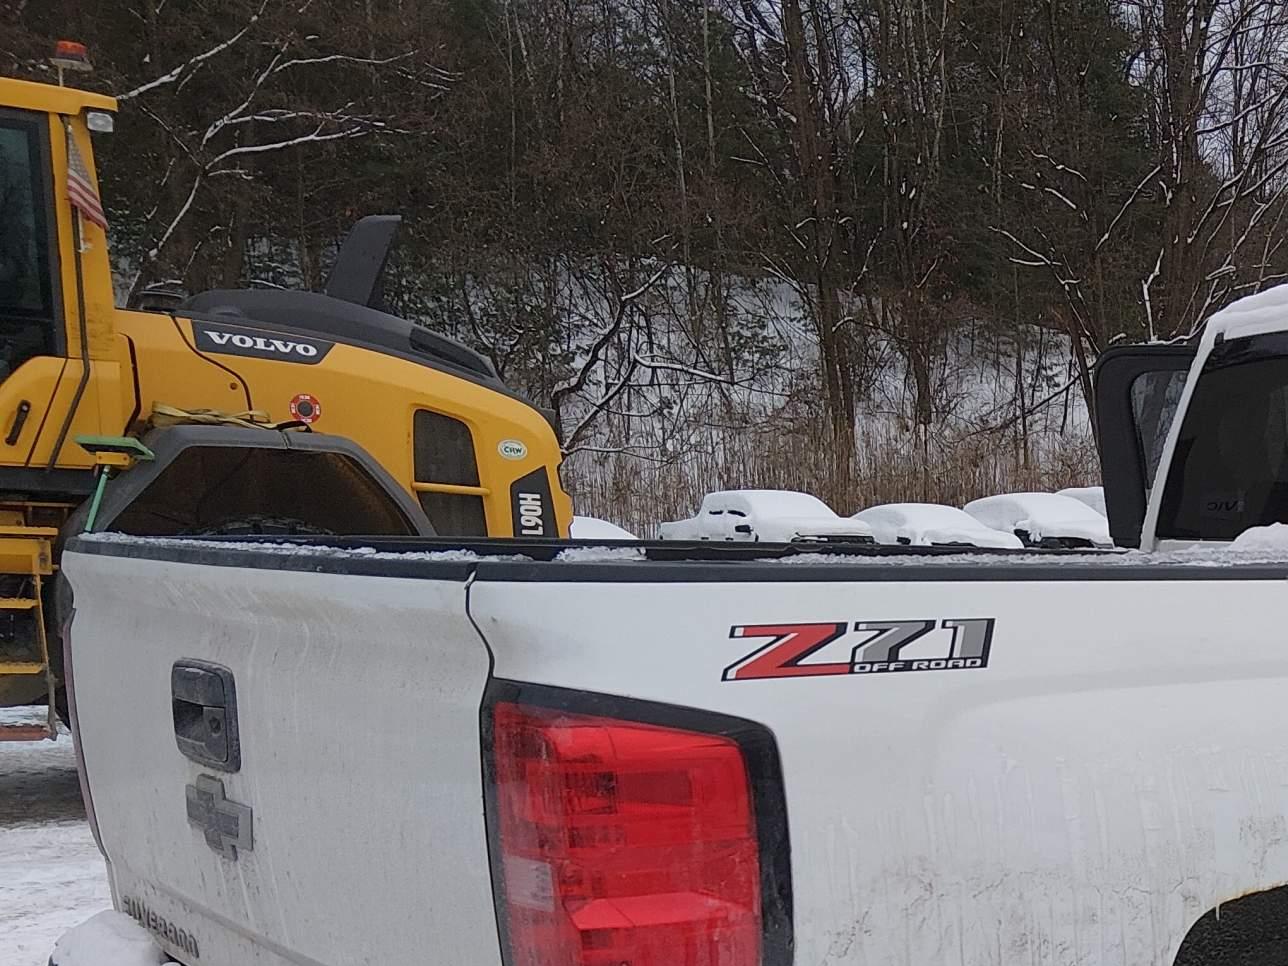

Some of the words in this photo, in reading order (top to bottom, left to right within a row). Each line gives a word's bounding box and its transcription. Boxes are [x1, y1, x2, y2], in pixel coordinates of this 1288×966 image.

[203, 330, 318, 357] VOLVO
[518, 493, 544, 535] L90H
[720, 618, 996, 682] Z71
[853, 661, 905, 673] OFF
[911, 658, 982, 671] ROAD
